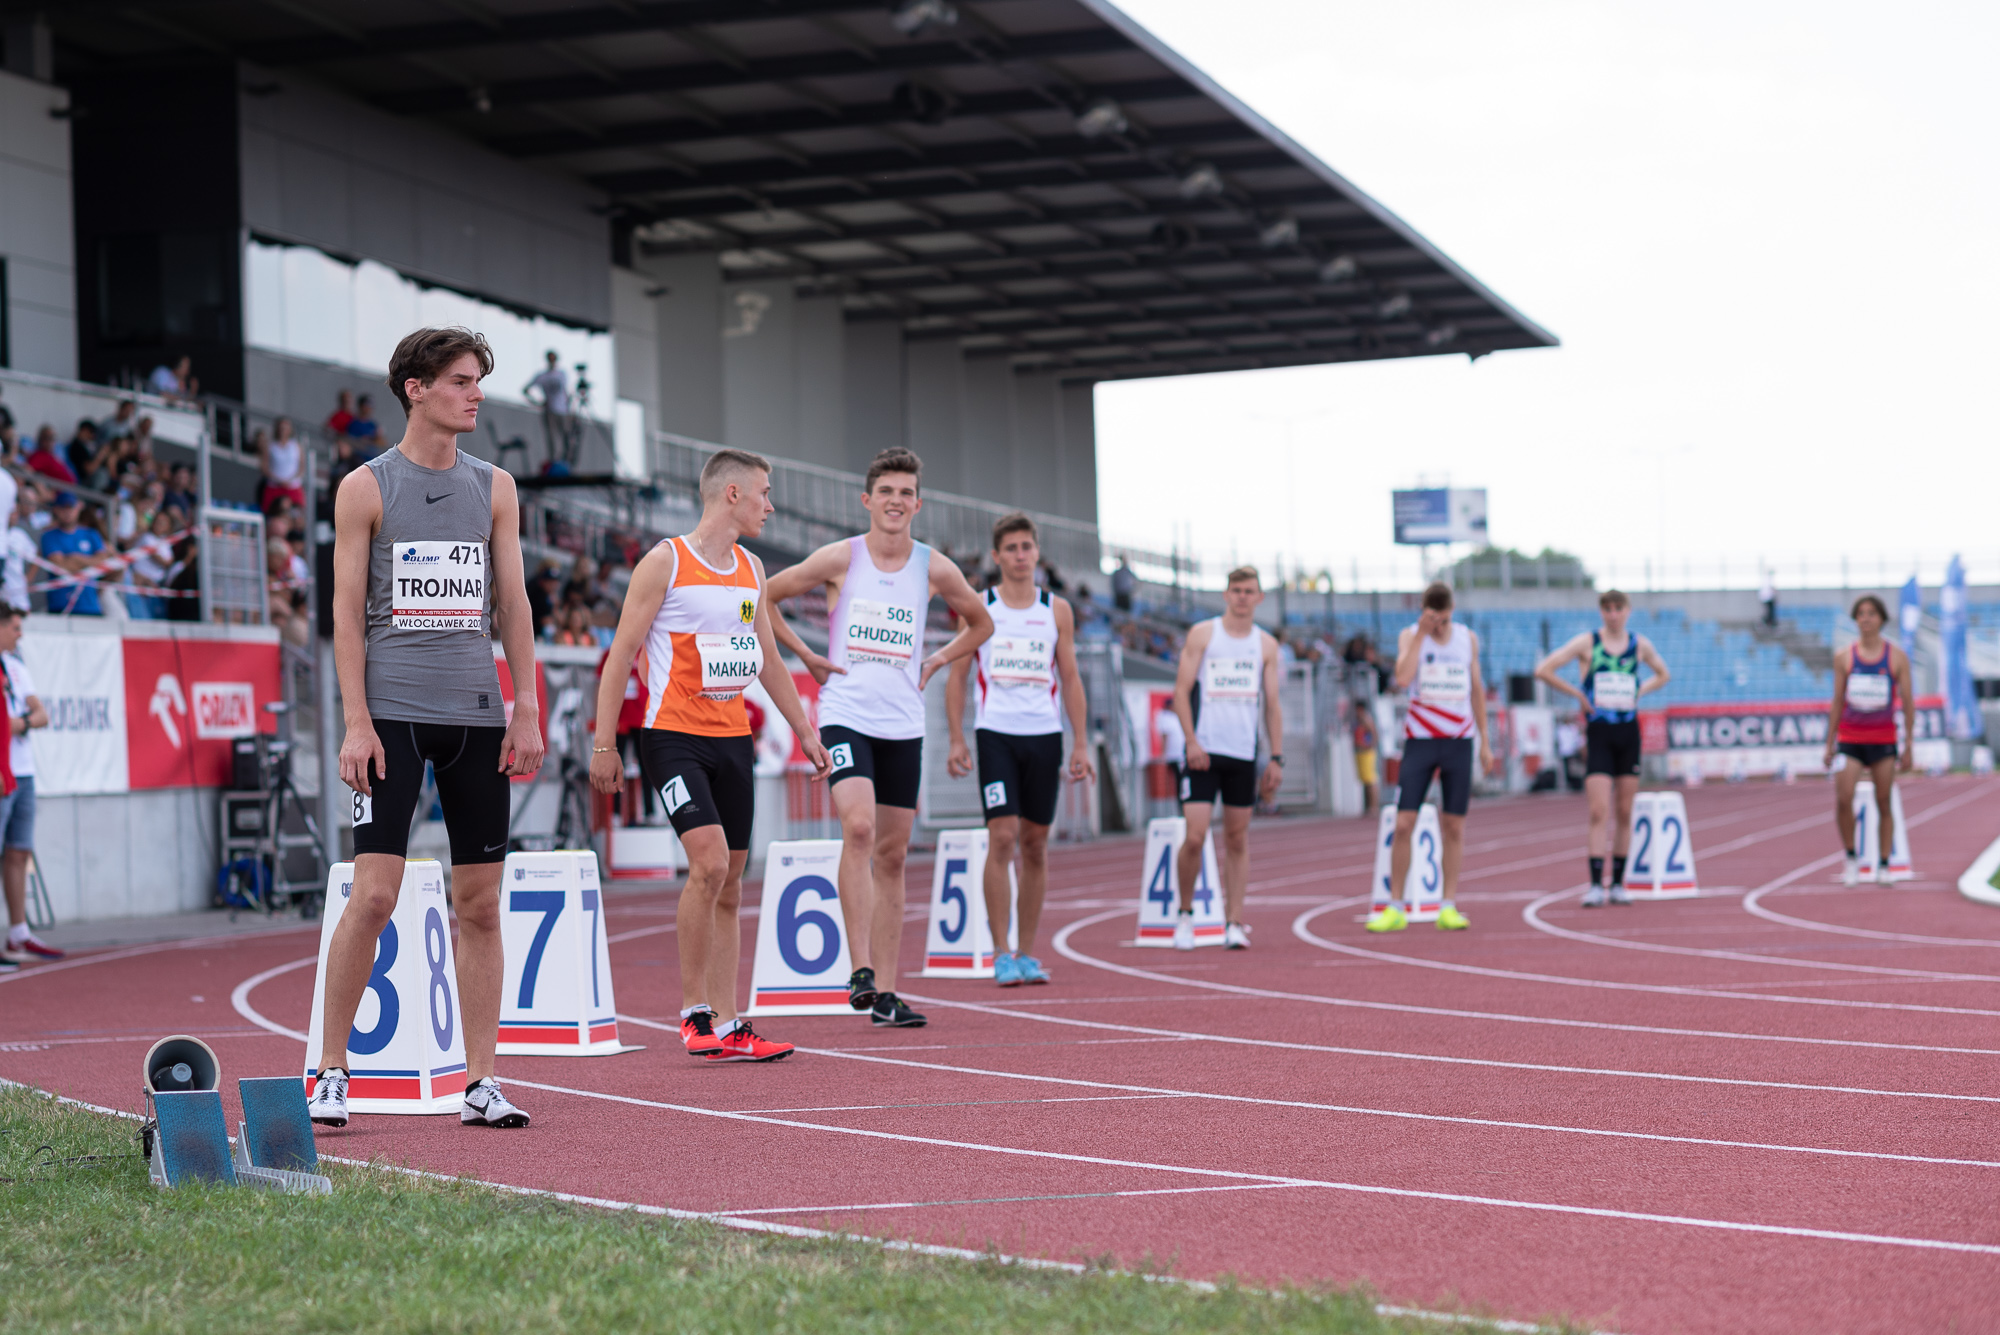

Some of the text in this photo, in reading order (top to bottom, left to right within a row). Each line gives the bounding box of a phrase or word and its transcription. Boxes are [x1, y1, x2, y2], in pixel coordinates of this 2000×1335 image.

[448, 545, 482, 565] 471
[397, 578, 482, 599] TROJNAR
[398, 618, 465, 628] WŁOCŁAWEK
[887, 607, 913, 623] 505
[730, 636, 756, 651] 569
[848, 624, 913, 647] CHUDZIK
[708, 661, 757, 678] MAKIŁA
[832, 747, 846, 767] 6
[353, 791, 365, 823] 8
[664, 780, 678, 808] 7
[989, 786, 1000, 804] 5
[1633, 816, 1653, 874] 2
[1662, 816, 1686, 874] 2
[1419, 830, 1439, 893] 3
[1148, 844, 1175, 917] 4
[939, 859, 968, 944] 5
[776, 874, 841, 976] 6
[509, 890, 566, 1009] 7
[581, 889, 600, 1008] 7
[424, 906, 454, 1052] 8
